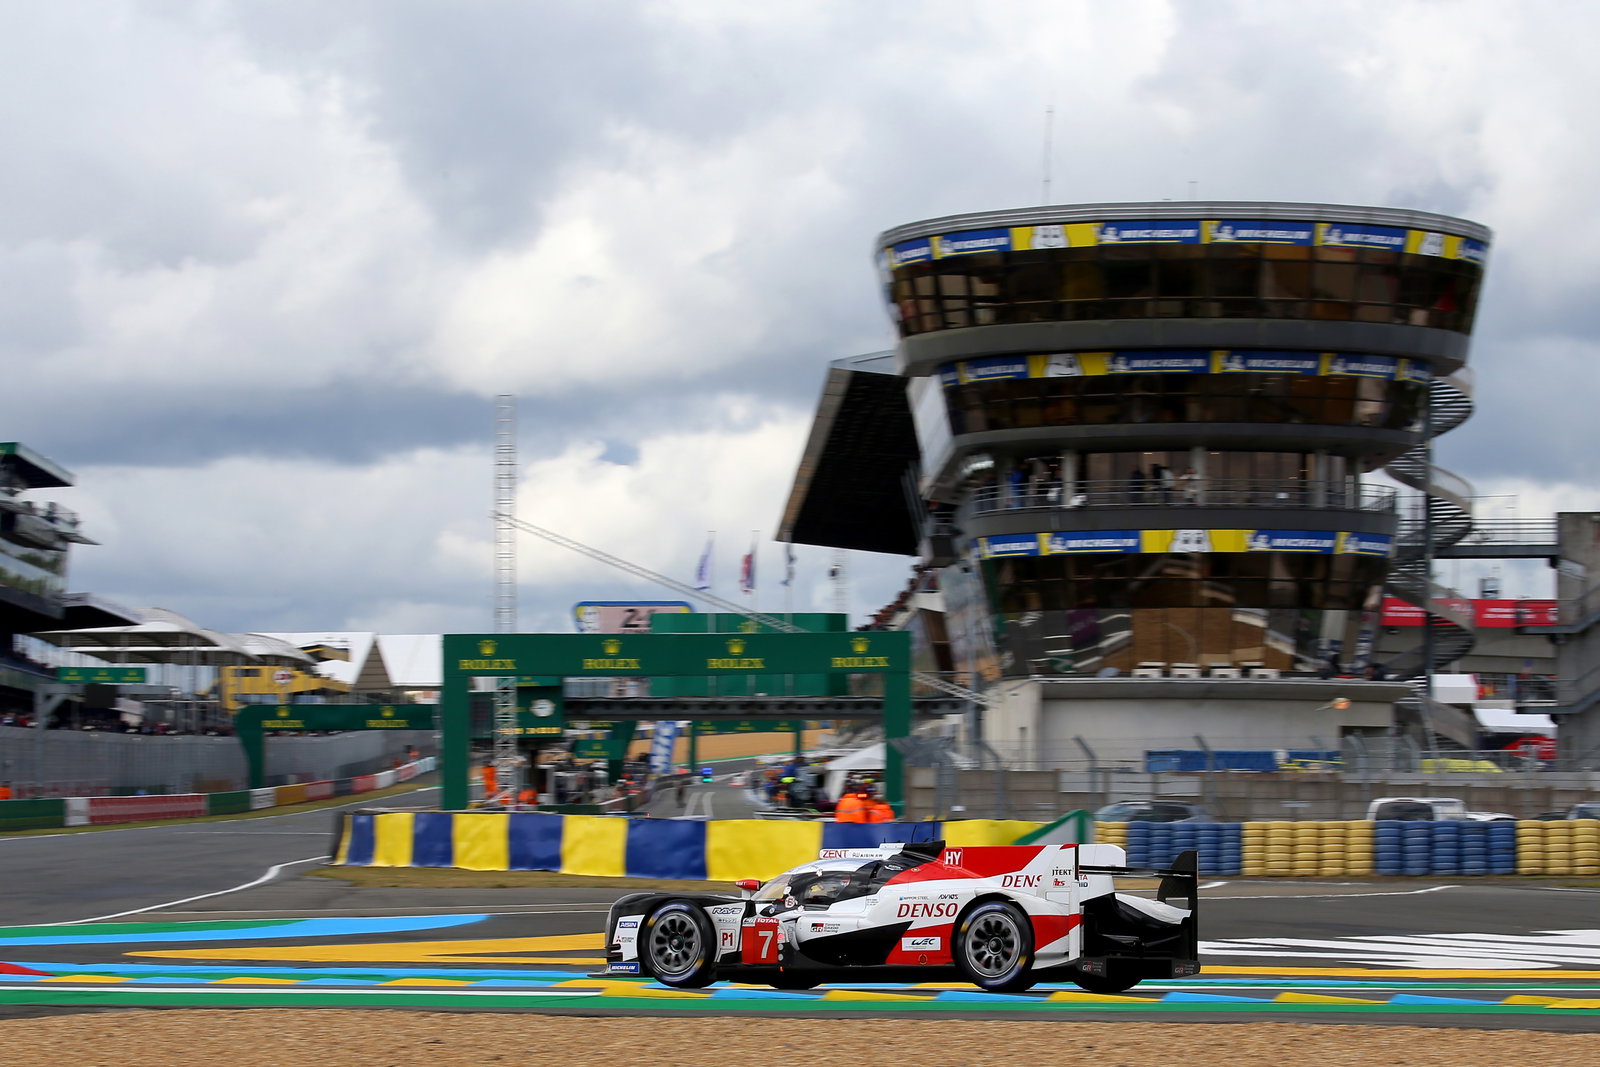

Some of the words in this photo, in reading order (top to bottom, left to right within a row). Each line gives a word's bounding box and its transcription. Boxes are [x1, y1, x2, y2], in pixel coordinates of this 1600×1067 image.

[1119, 229, 1199, 238] MICHELIN
[1067, 538, 1137, 548] MICHELIN
[1271, 538, 1334, 547] MICHELIN
[458, 659, 517, 669] ROLEX
[583, 658, 640, 669] ROLEX
[707, 658, 765, 668] ROLEX
[831, 657, 890, 667] ROLEX
[822, 850, 849, 858] ZENT
[945, 851, 962, 865] HY
[1052, 867, 1072, 876] JTEKT
[1001, 874, 1042, 888] DENS
[897, 903, 958, 917] DENSO
[722, 932, 733, 946] P1
[758, 931, 773, 959] 7
